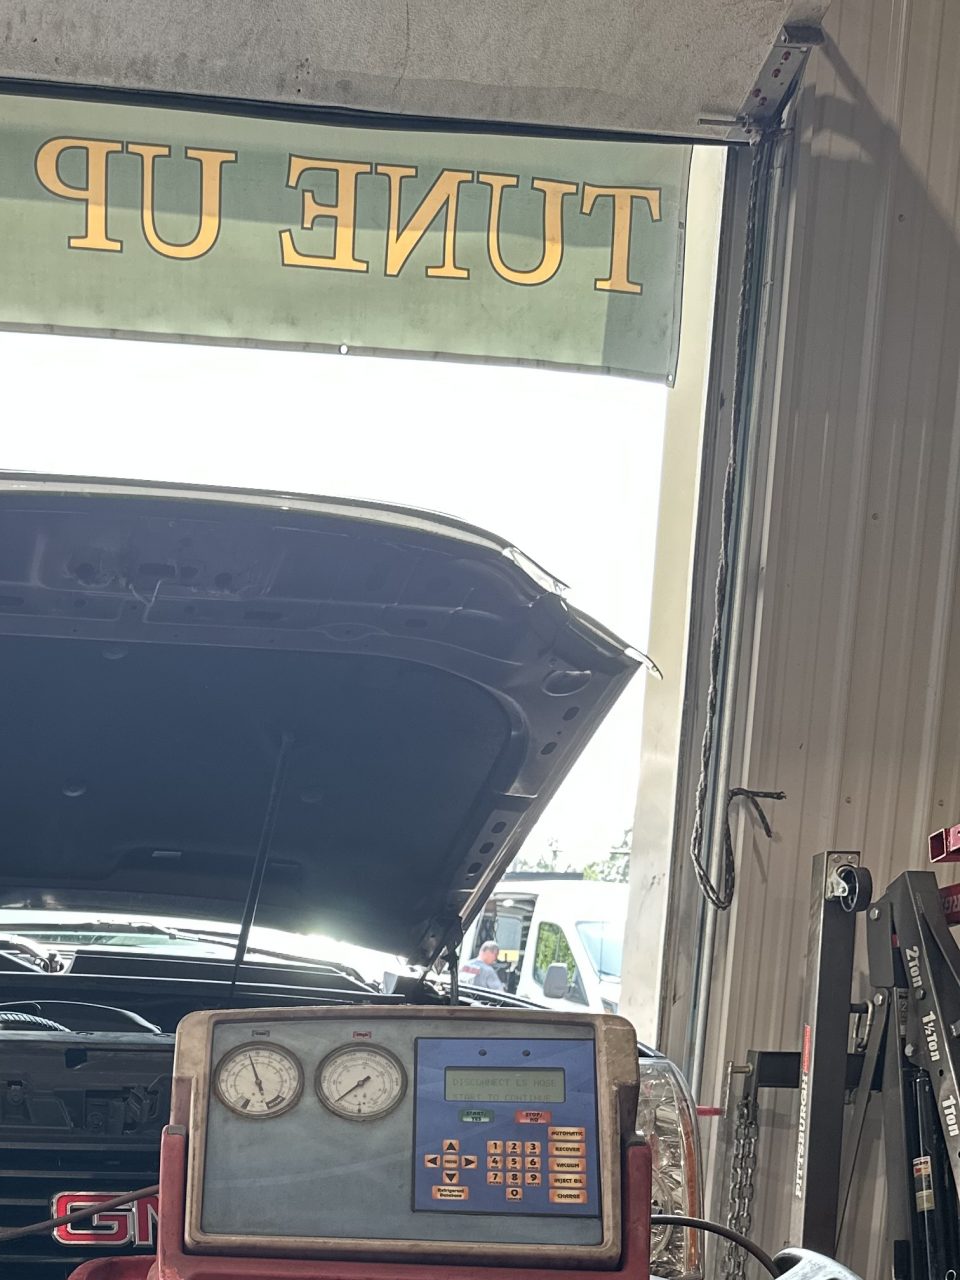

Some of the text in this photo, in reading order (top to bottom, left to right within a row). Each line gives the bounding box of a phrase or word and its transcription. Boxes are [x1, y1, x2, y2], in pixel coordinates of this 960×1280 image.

[795, 1075, 809, 1199] PITTSBURGH
[493, 1142, 498, 1150] 1
[492, 1157, 499, 1165] 4
[530, 1158, 537, 1166] 6
[511, 1173, 518, 1181] 8
